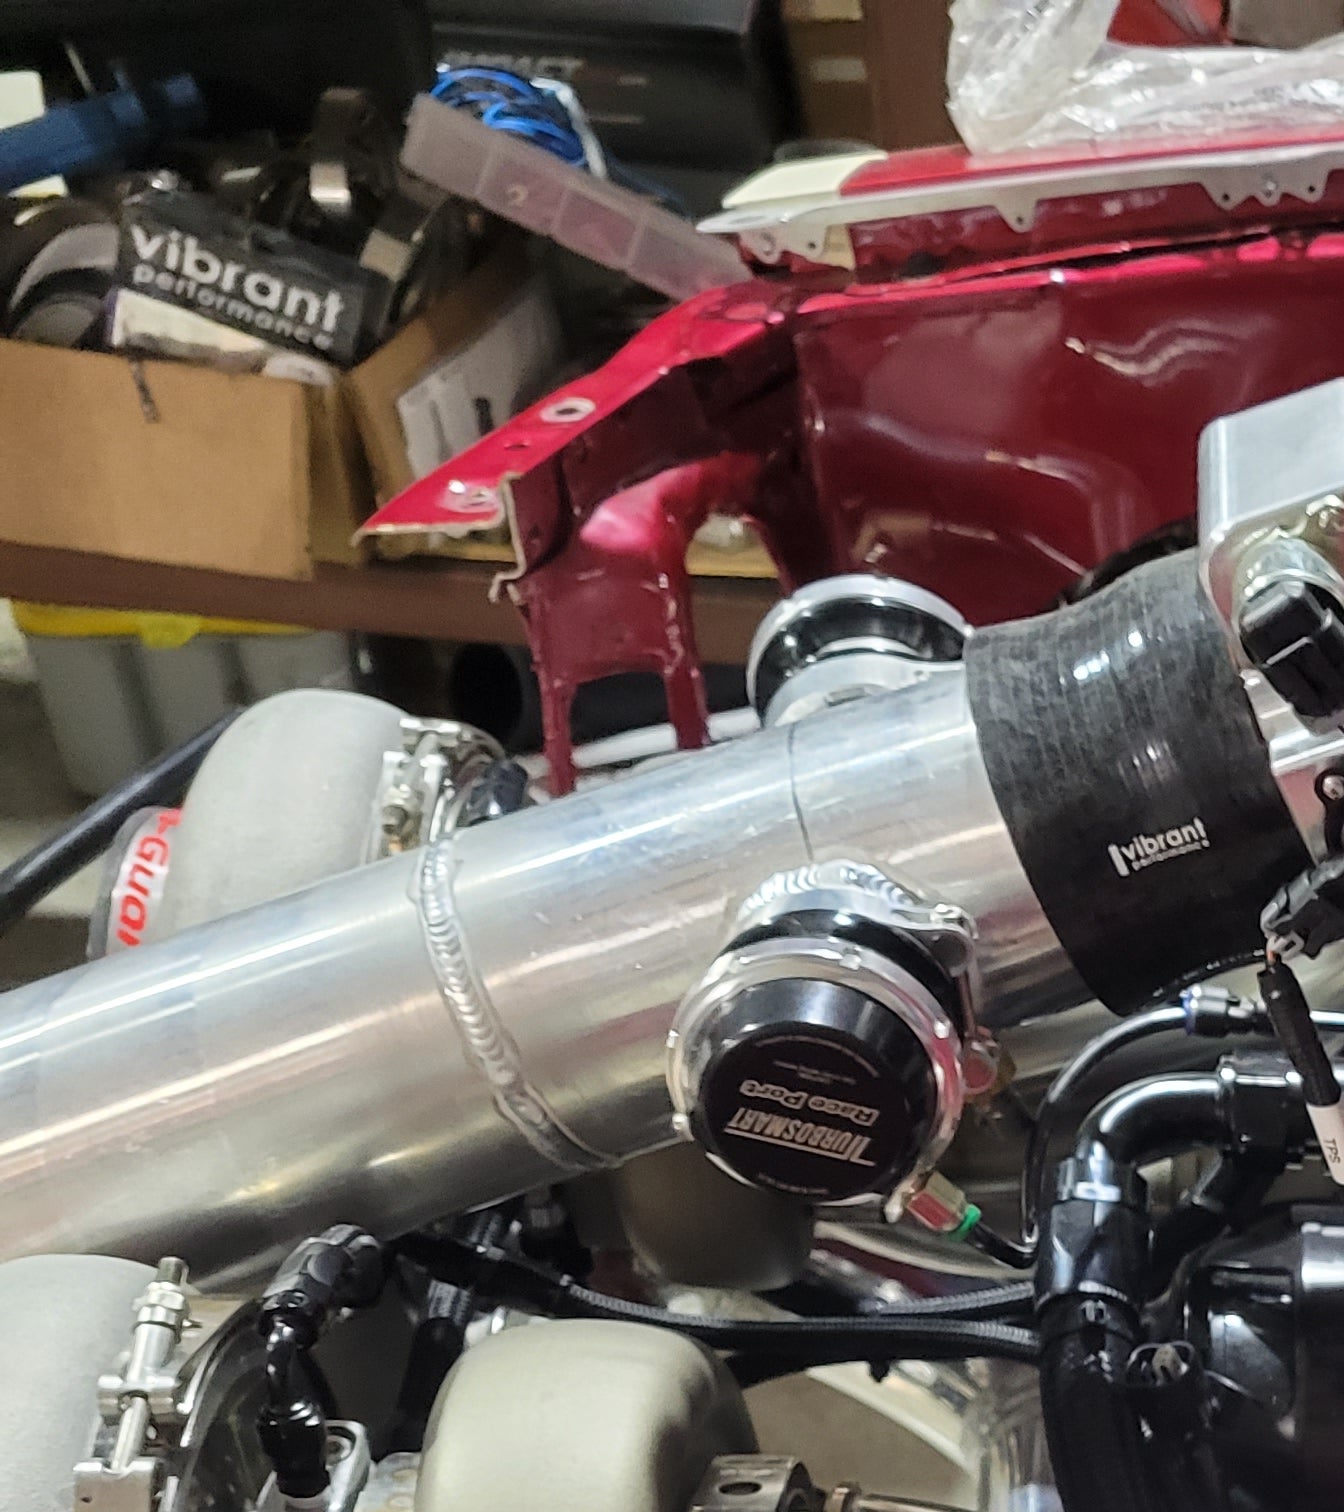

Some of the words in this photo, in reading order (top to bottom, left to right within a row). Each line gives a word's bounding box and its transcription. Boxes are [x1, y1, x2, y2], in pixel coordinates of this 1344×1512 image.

[131, 224, 345, 333] vibrant
[132, 262, 335, 351] performance
[1119, 815, 1207, 860] vibrant
[739, 1079, 809, 1111] Port
[807, 1095, 880, 1128] Race
[723, 1106, 877, 1168] TURBOSMART
[1323, 1137, 1342, 1164] TPS
